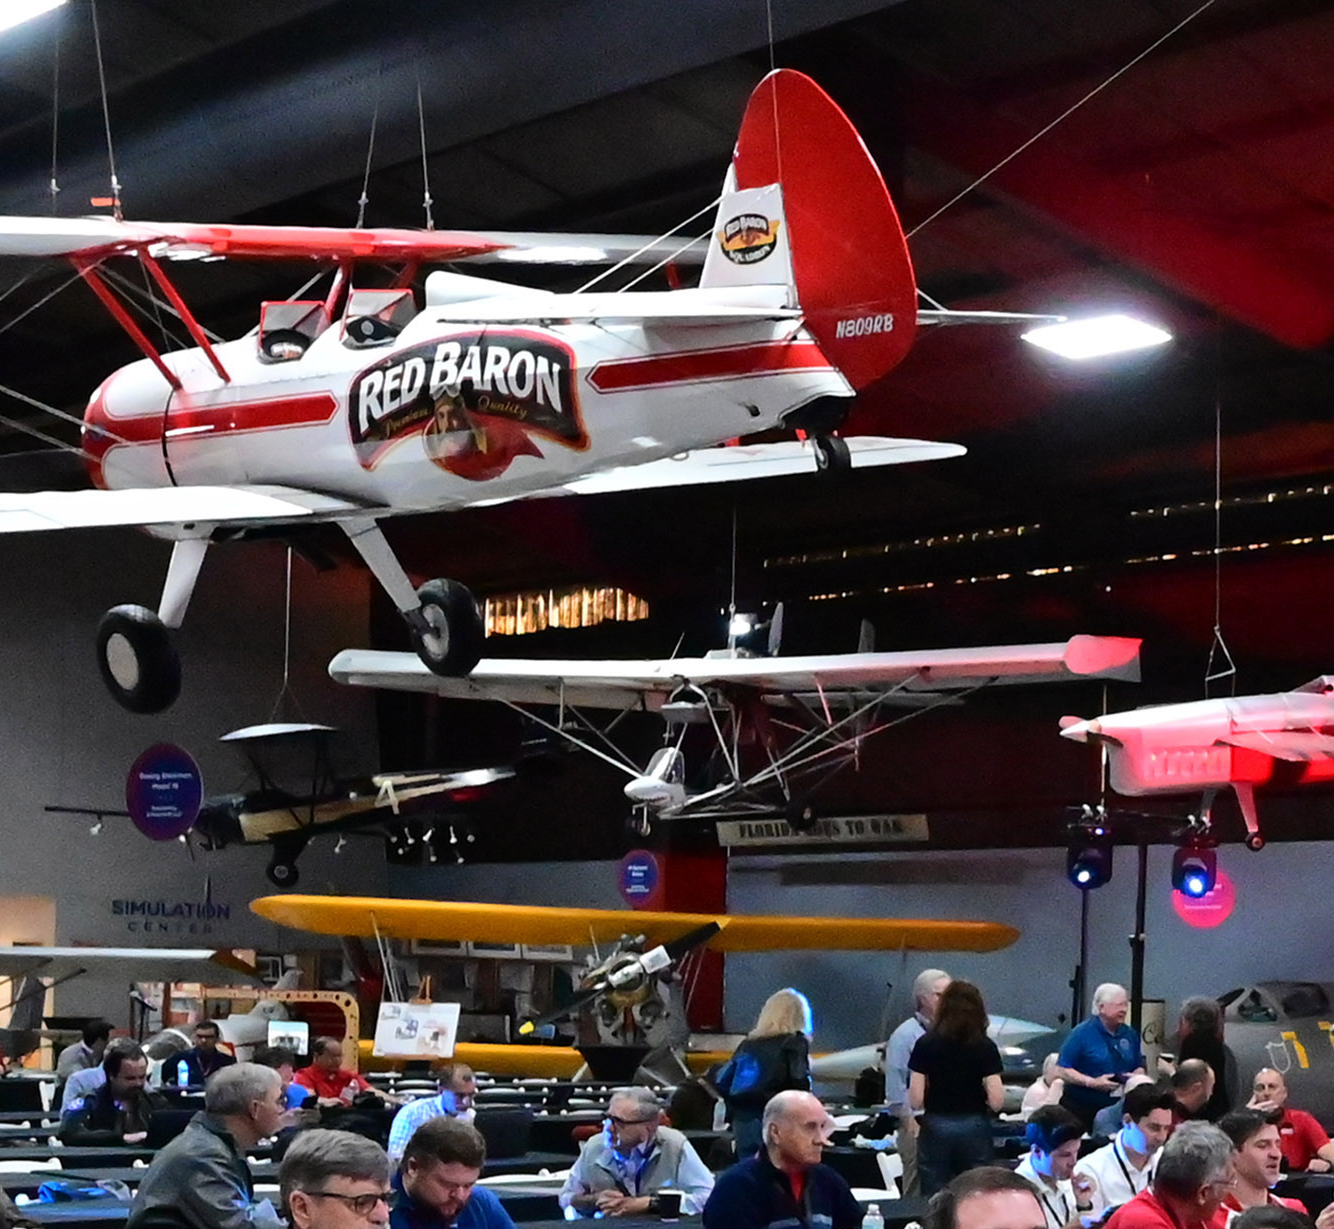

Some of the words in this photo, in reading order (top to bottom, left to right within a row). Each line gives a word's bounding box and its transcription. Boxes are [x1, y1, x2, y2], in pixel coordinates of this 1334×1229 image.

[835, 312, 894, 339] N809RB
[358, 356, 427, 435] RED
[429, 341, 563, 414] BARON
[739, 822, 798, 839] FLORID
[112, 899, 230, 919] SIMULATION
